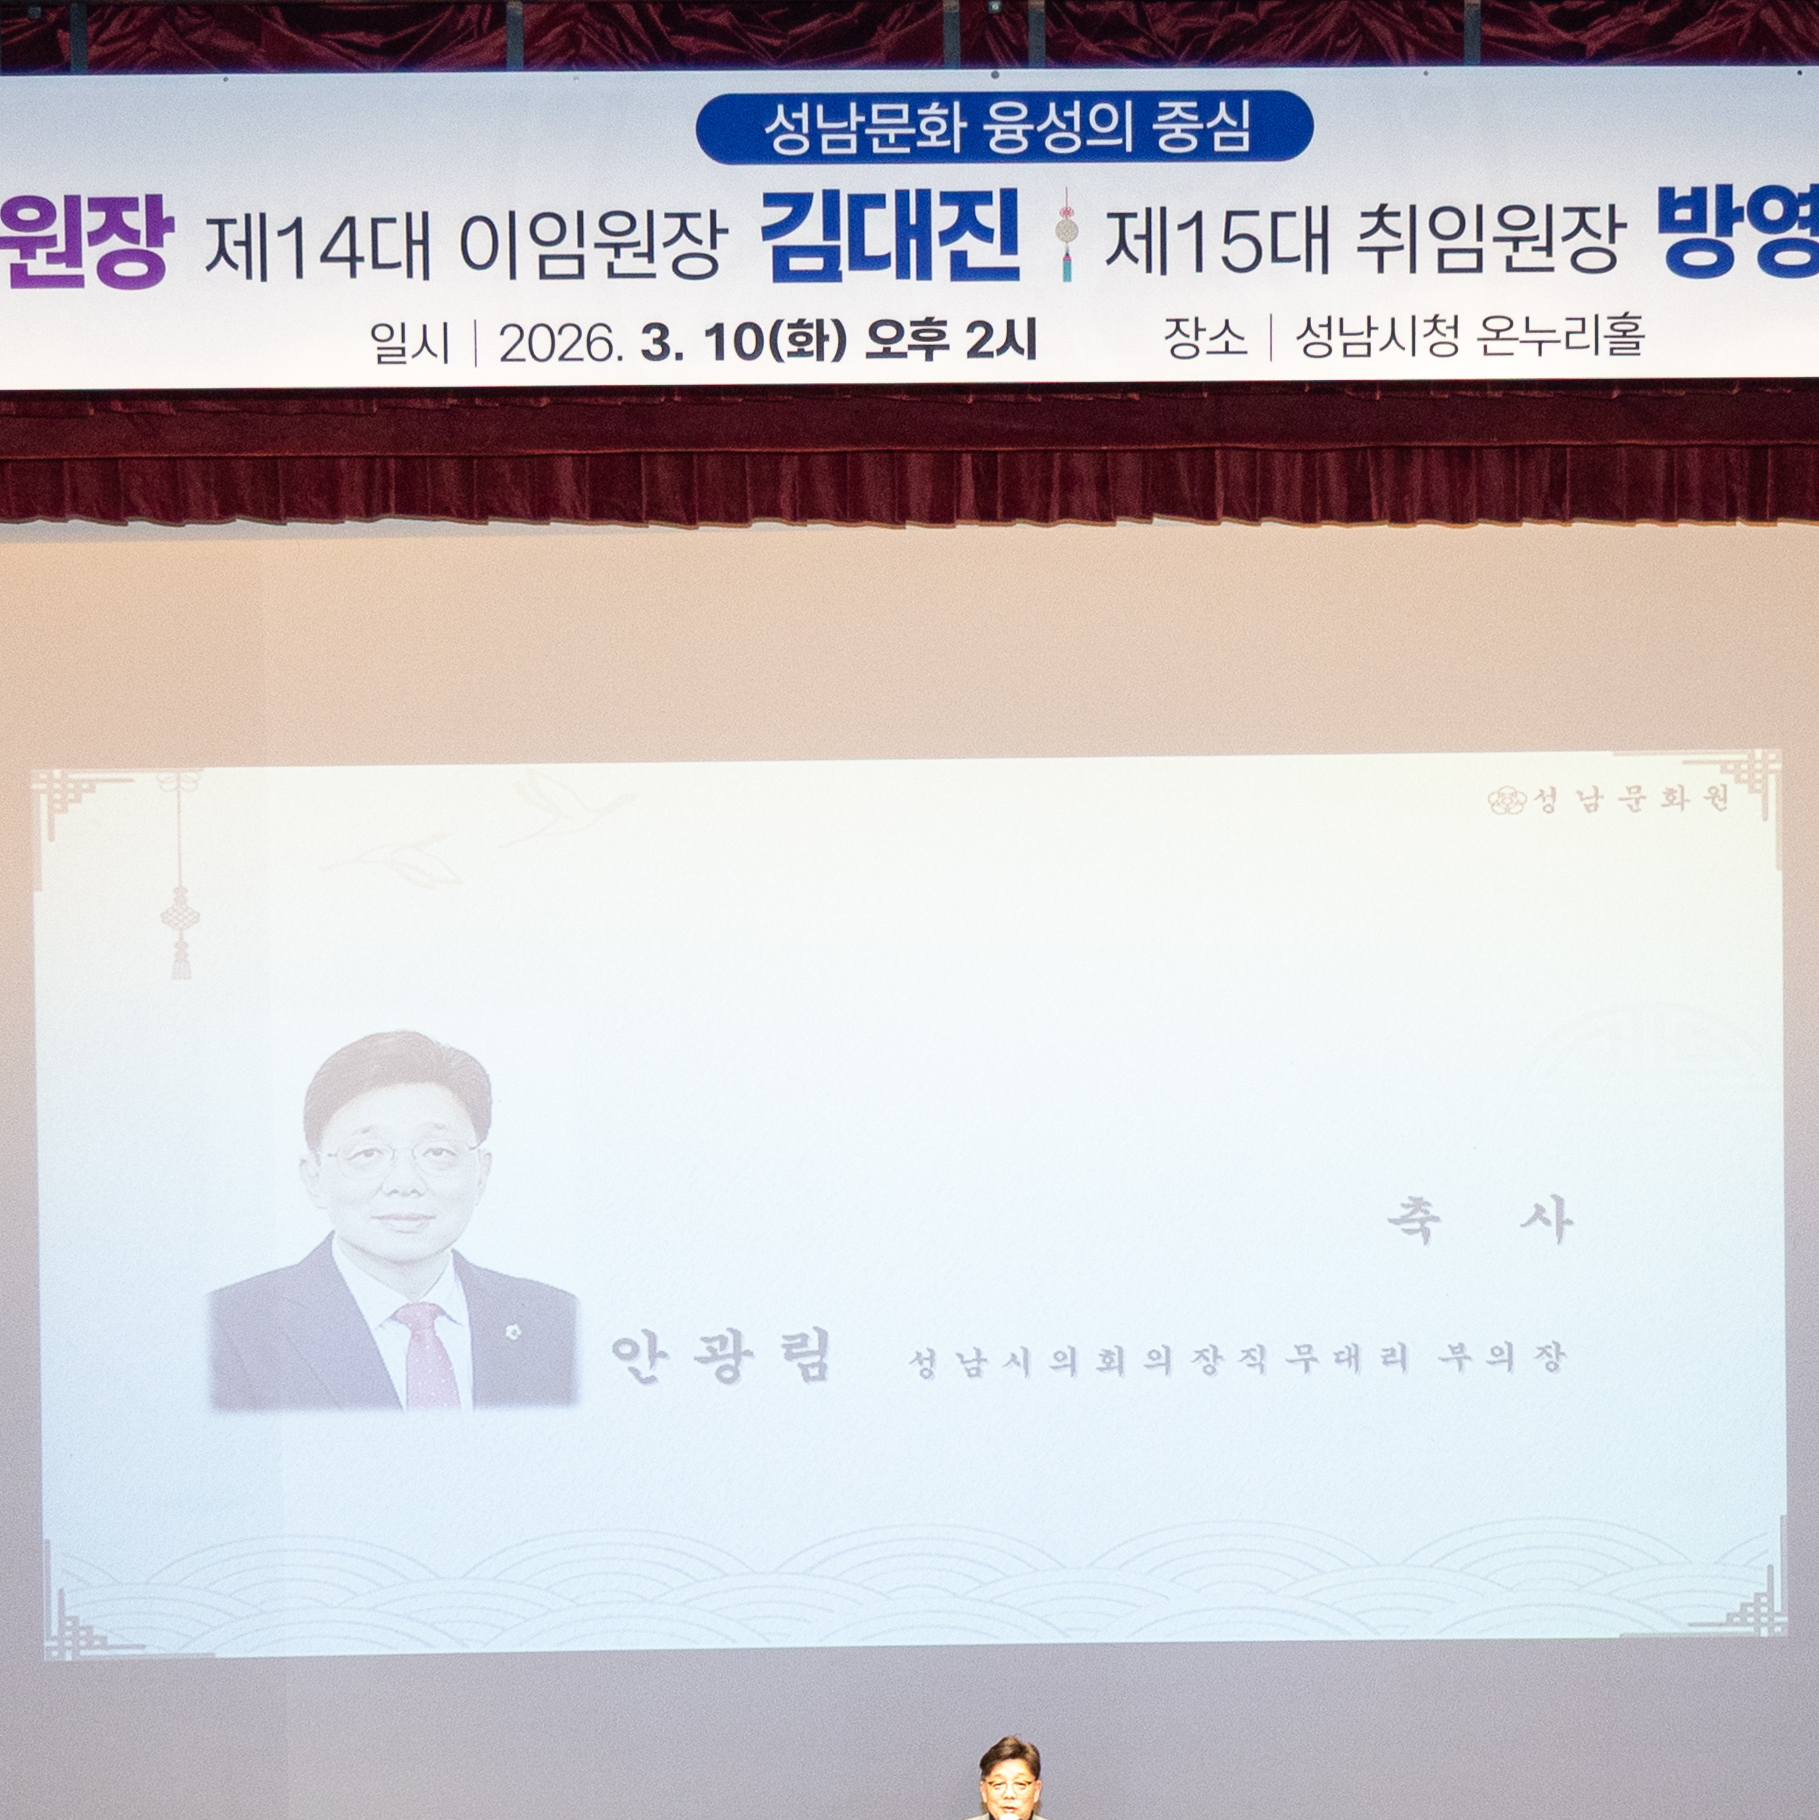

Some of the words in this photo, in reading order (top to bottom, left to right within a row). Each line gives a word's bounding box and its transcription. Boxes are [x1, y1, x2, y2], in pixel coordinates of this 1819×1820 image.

[765, 100, 968, 157] 성남문화
[985, 98, 1136, 155] 융성의
[1152, 97, 1256, 153] 중심
[206, 211, 431, 283] 제14대
[460, 209, 731, 283] 이임원장
[761, 188, 1022, 285] 김대진
[1106, 205, 1331, 278] 제15대
[1357, 203, 1630, 276] 취임원장
[371, 321, 451, 367] 일시
[500, 322, 625, 365] 2026.
[641, 322, 685, 364] 3.
[705, 318, 849, 365] 10(화)
[865, 316, 952, 364] 오후
[966, 317, 1038, 362] 2시
[1165, 316, 1251, 362] 장소
[1296, 313, 1466, 361] 성남시청
[1477, 311, 1647, 359] 온누리홀
[1534, 784, 1727, 813] 성남문화원
[1439, 1341, 1568, 1376] 부의장
